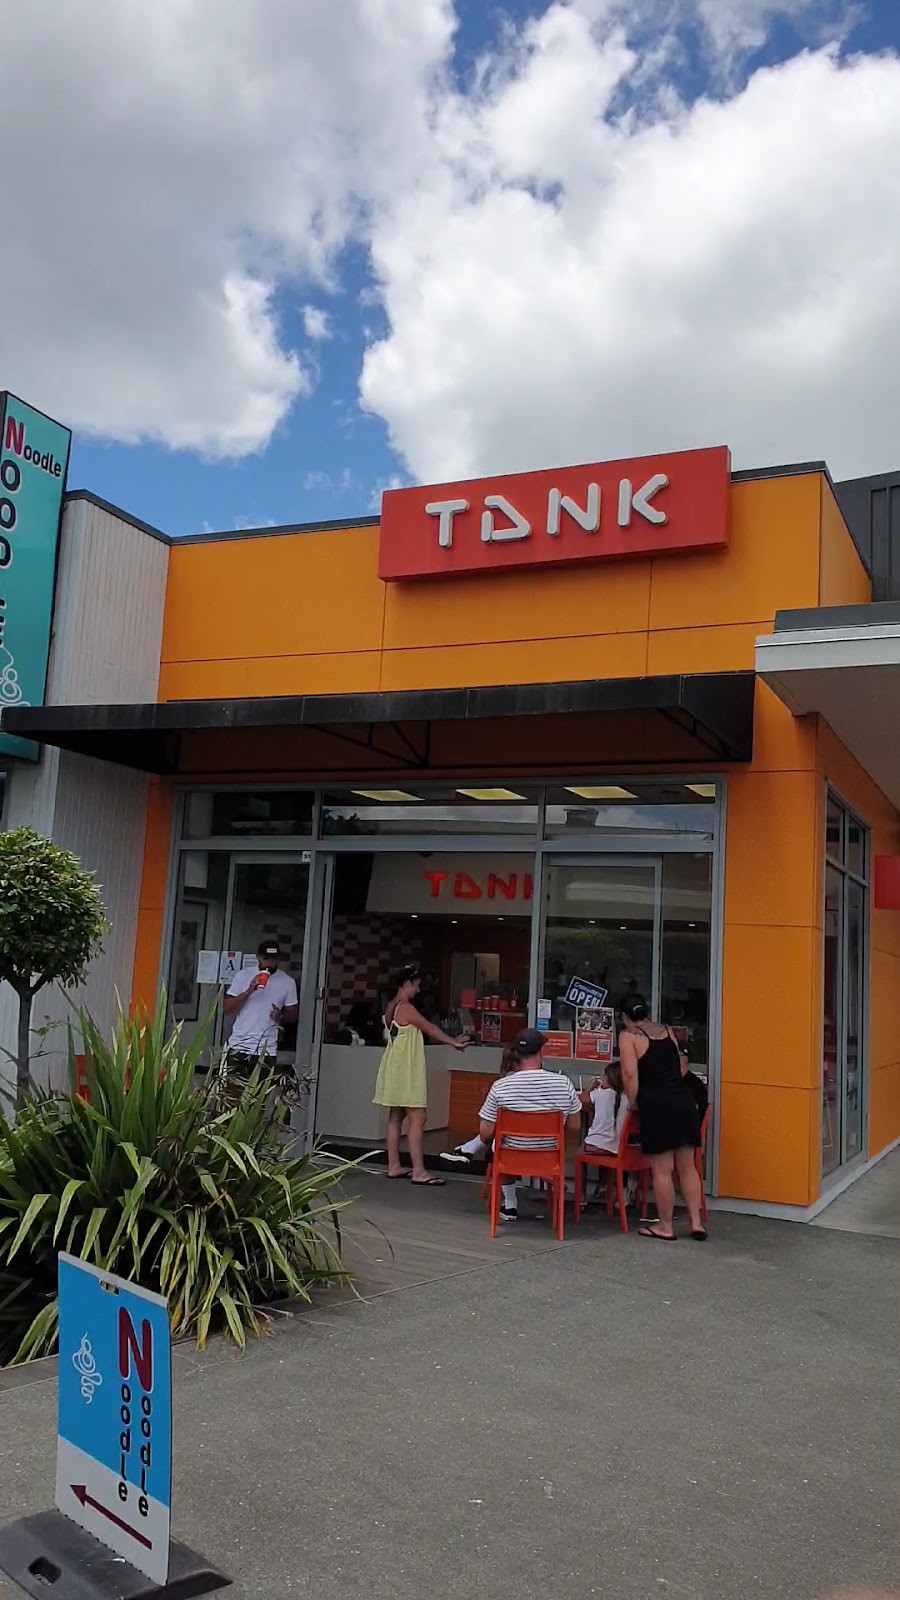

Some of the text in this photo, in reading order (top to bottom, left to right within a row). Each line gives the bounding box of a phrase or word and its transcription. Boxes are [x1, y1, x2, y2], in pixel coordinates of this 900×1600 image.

[5, 415, 62, 478] Noodle
[425, 473, 669, 548] TANK
[226, 959, 235, 971] A
[569, 988, 601, 1008] OPEN
